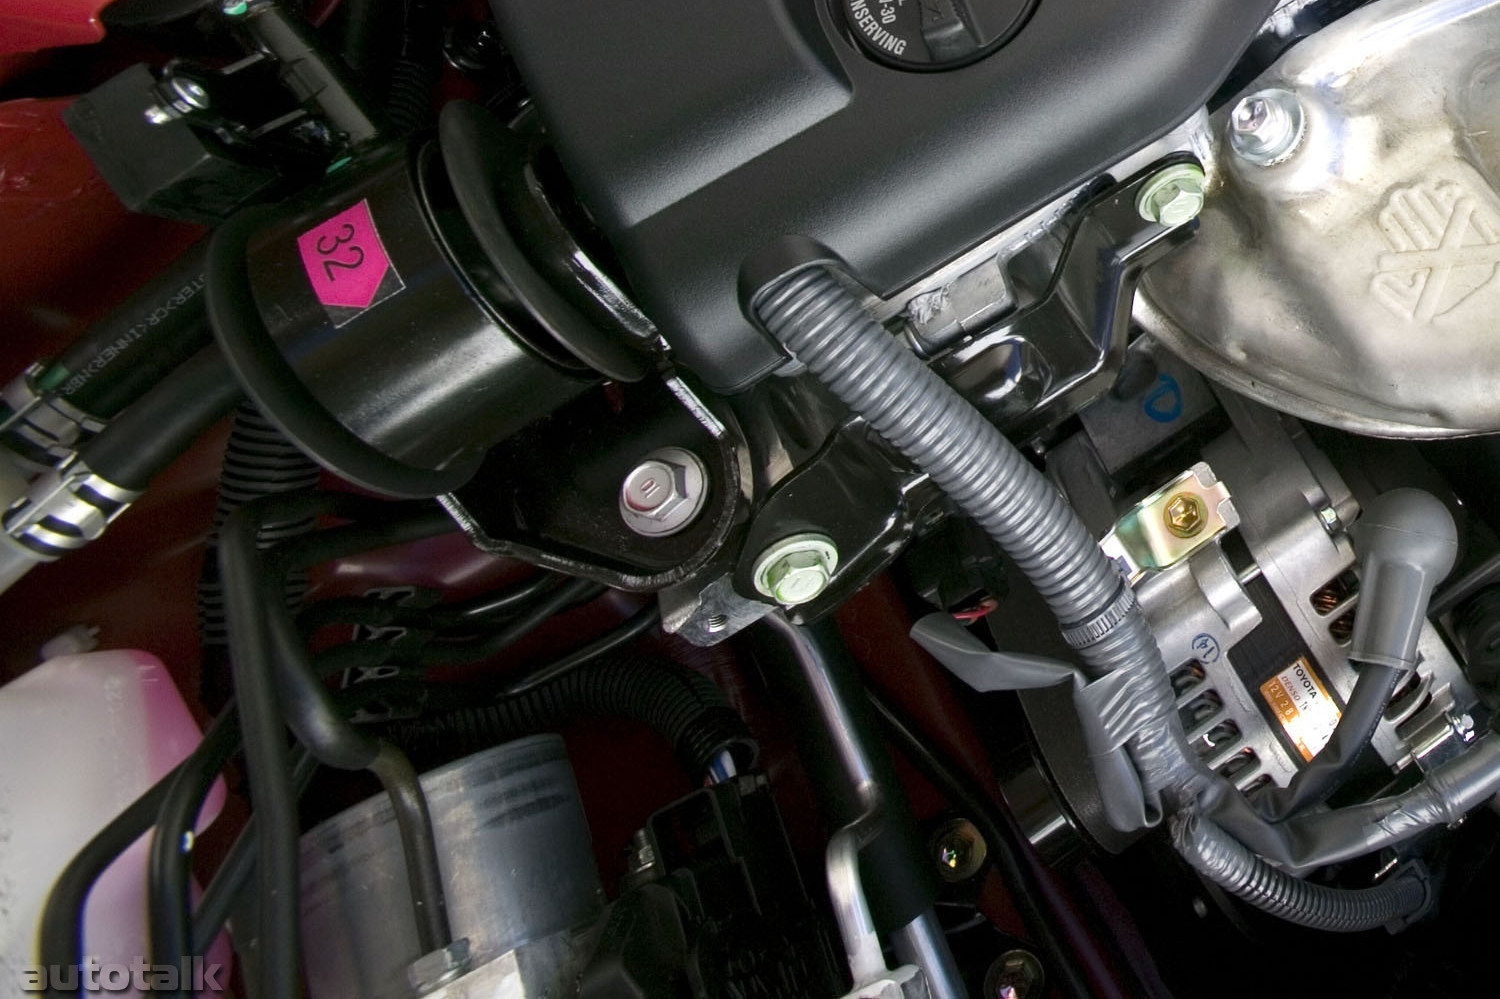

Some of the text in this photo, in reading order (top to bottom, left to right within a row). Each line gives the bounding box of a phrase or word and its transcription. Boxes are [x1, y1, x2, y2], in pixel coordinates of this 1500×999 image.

[316, 224, 363, 281] 32
[1281, 675, 1301, 702] DENSO
[1292, 662, 1318, 699] TOYOTA
